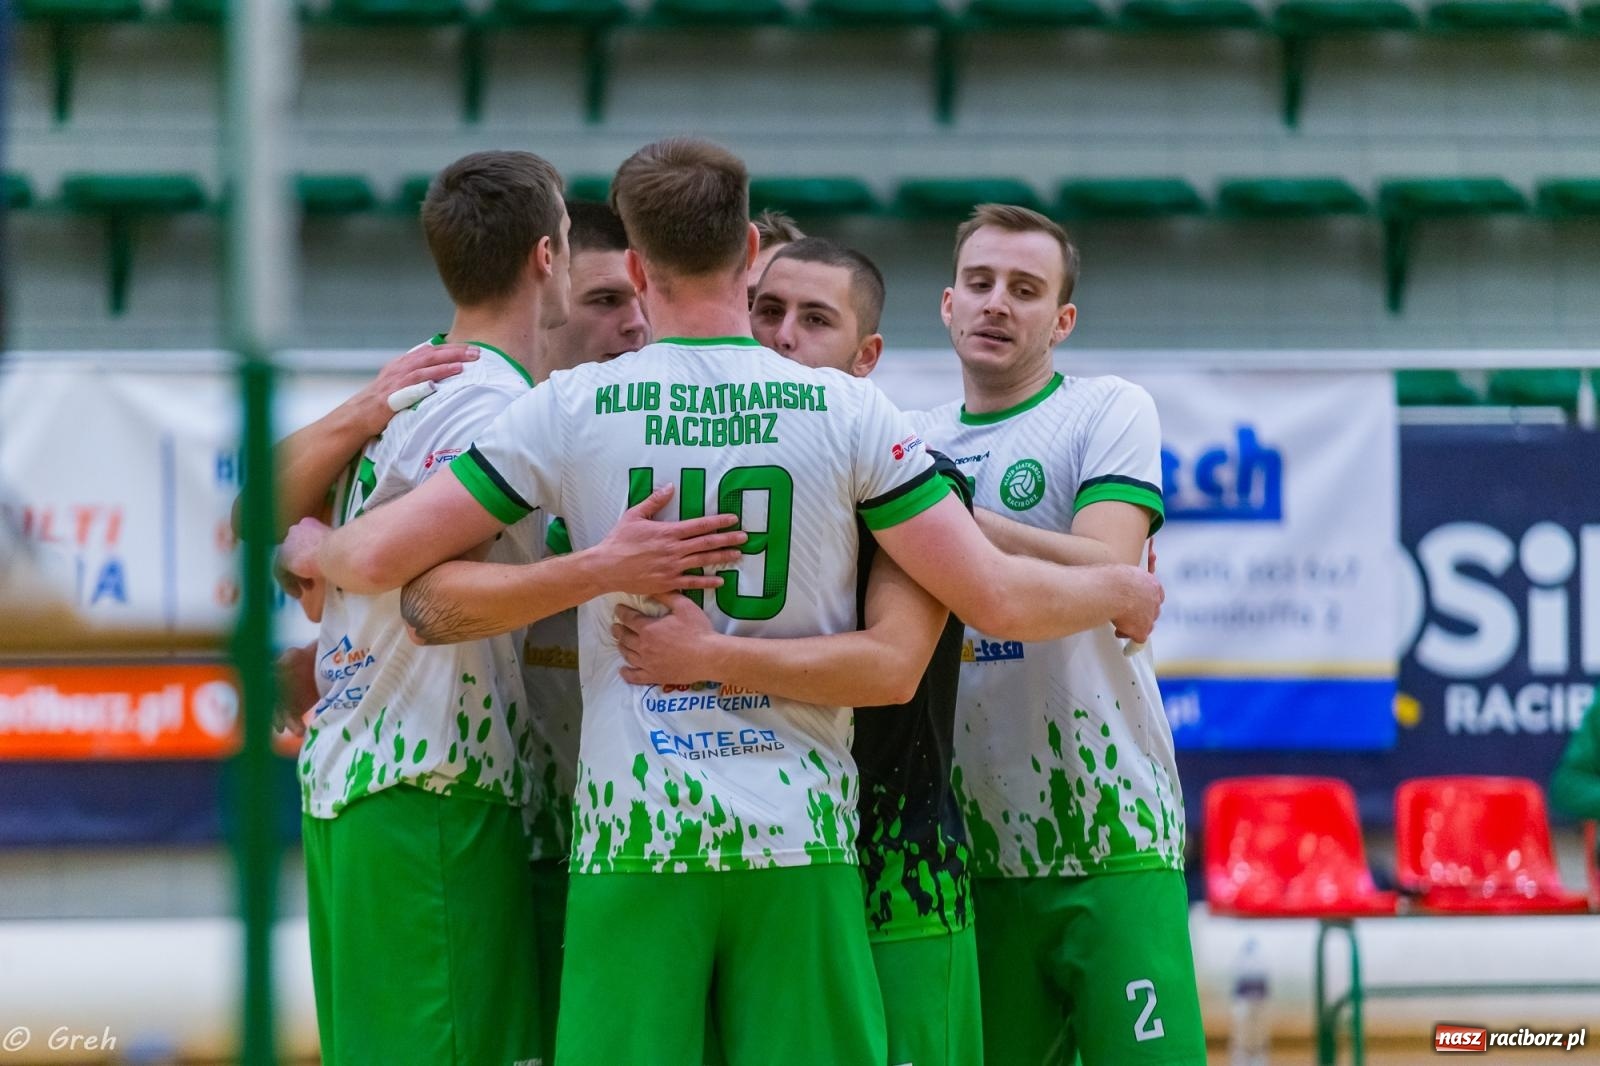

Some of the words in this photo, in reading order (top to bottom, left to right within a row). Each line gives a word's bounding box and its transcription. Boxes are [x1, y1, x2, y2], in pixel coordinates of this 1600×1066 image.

[595, 381, 661, 414] KLUB
[670, 381, 828, 414] SIATKARSKI
[645, 411, 778, 447] RACIBÓRZ
[1126, 978, 1165, 1042] 2
